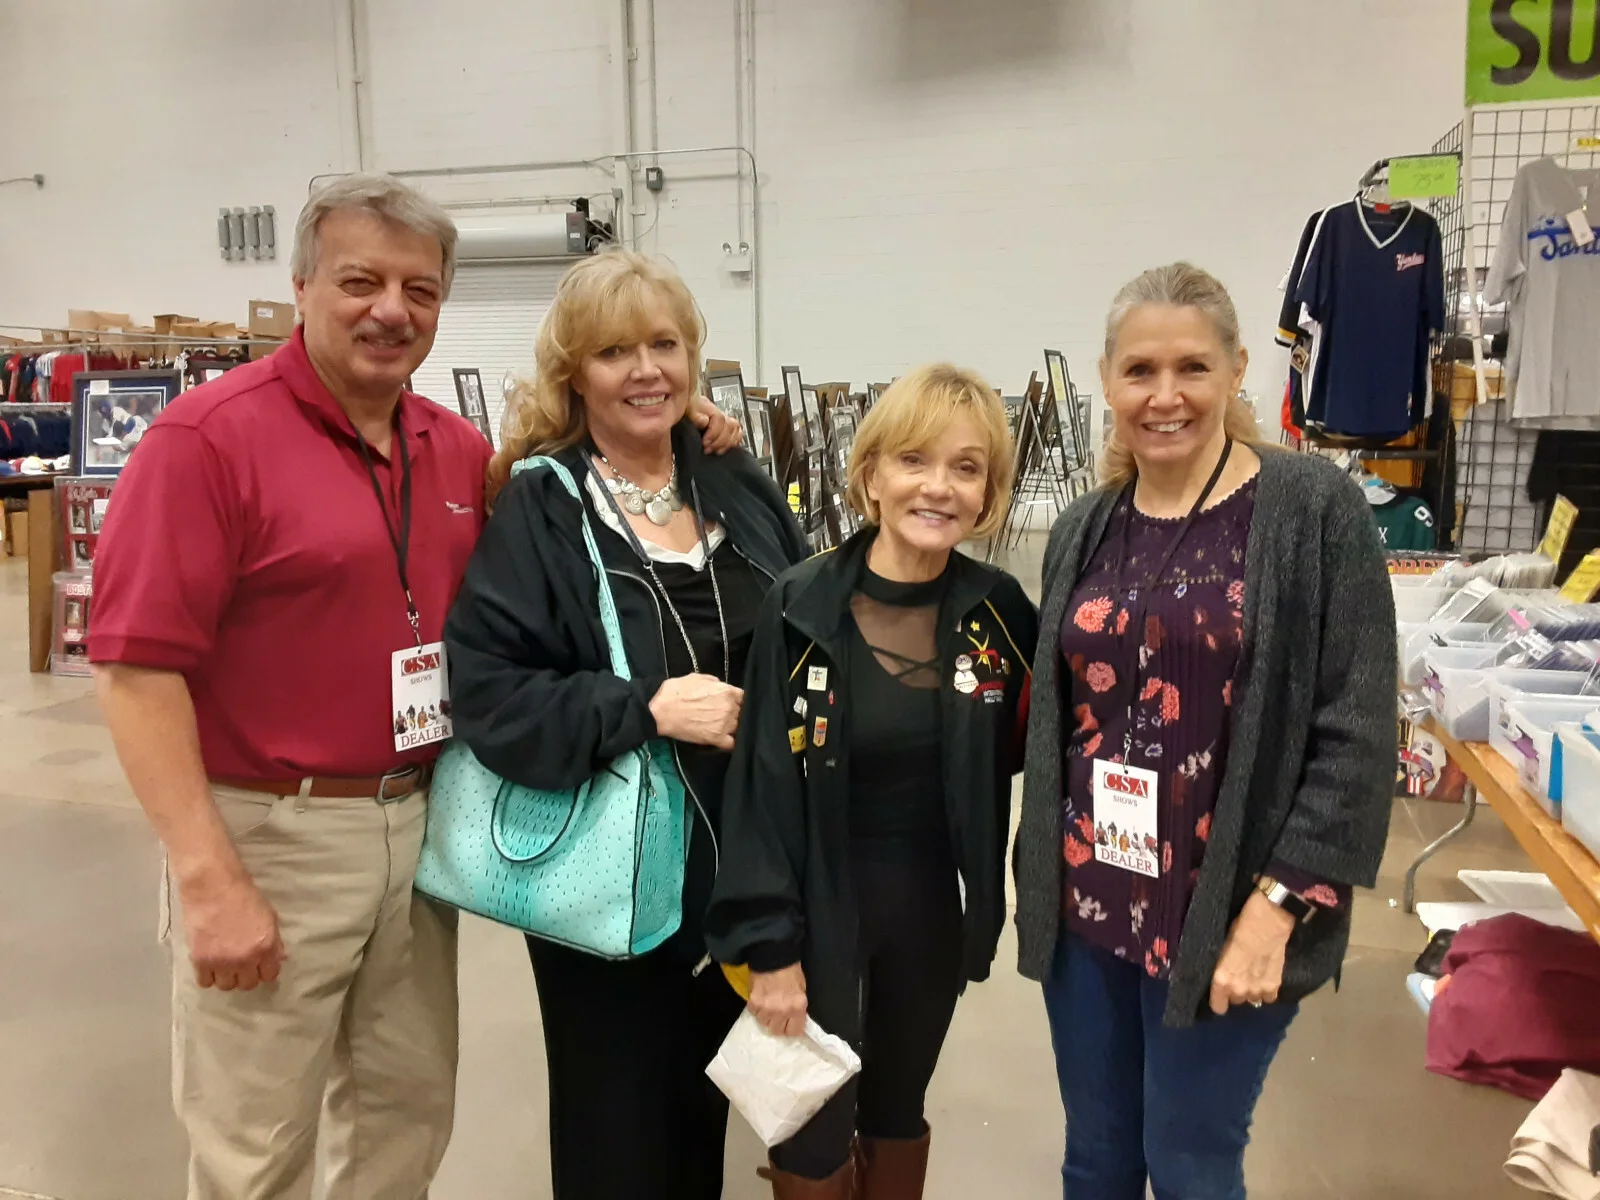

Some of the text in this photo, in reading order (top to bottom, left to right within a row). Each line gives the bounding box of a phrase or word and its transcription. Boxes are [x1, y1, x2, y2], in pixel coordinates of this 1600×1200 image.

[1490, 0, 1600, 86] SU
[401, 653, 440, 676] CSA
[410, 674, 433, 686] SHOWS
[401, 725, 449, 748] DEALER
[1104, 772, 1148, 798] CSA
[1113, 795, 1138, 807] SHOWS
[1101, 848, 1154, 875] DEALER
